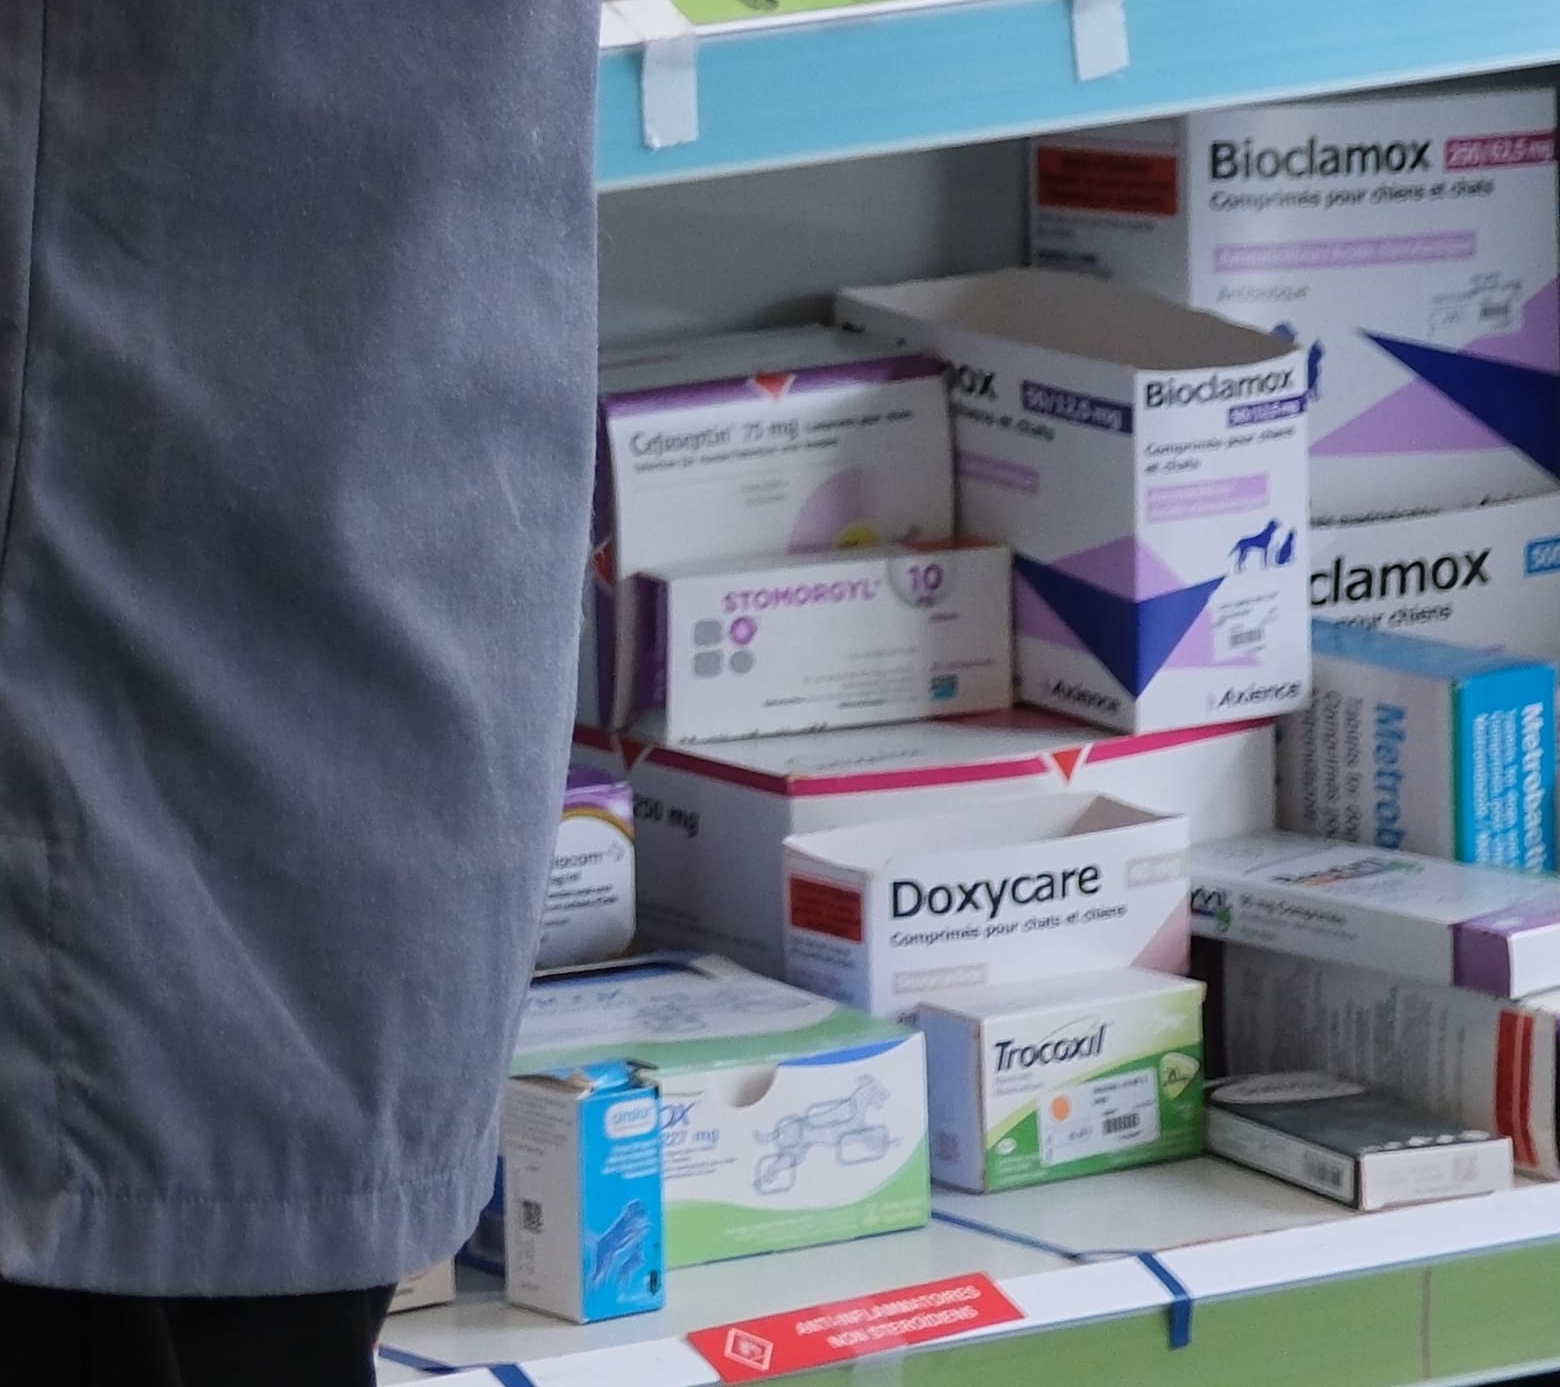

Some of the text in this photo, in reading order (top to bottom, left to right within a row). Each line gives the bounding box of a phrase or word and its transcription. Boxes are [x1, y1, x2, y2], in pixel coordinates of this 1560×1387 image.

[1208, 134, 1434, 180] Bioclamox
[1209, 177, 1496, 212] Comprimés pour chiens chats
[1144, 367, 1295, 410] Bioclamox
[722, 562, 945, 615] STOMORGYL 10
[890, 862, 1102, 921] Doxycare
[890, 903, 1129, 949] Comprimés pour chats chiens
[993, 1021, 1109, 1073] Trocoxil
[795, 1283, 983, 1337] ANTI-INFLAMMATOIRES
[827, 1330, 868, 1350] NON
